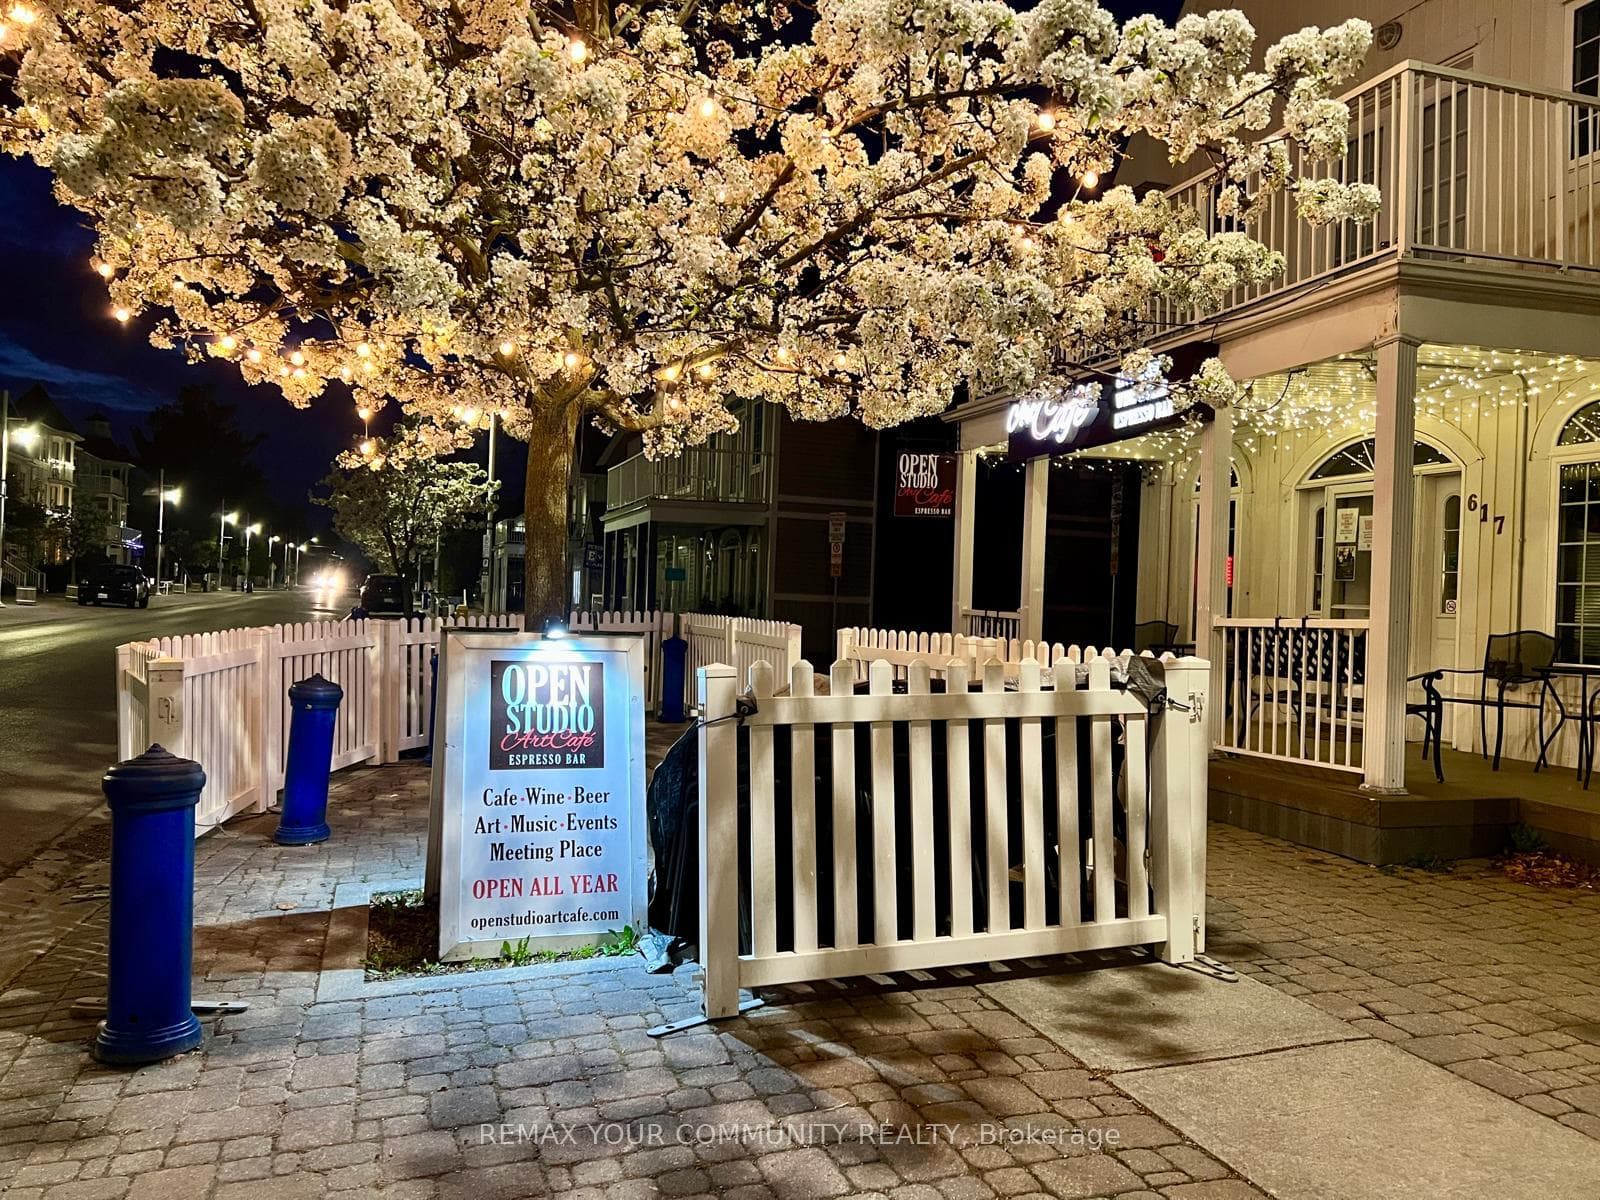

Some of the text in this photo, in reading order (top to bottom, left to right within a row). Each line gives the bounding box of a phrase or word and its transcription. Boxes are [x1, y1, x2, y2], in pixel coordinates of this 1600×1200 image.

[899, 453, 939, 475] OPEN
[900, 473, 938, 489] STUDIO
[914, 507, 940, 515] ESPRESSO
[502, 664, 591, 706] OPEN
[506, 703, 594, 734] STUDIO
[508, 753, 587, 766] ESPRESSO BAR
[483, 786, 611, 806] Cafe Wine Beer
[474, 813, 618, 834] Art Music Events
[490, 839, 603, 862] Meeting Place
[472, 873, 619, 900] OPEN ALL YEAR
[470, 906, 619, 931] openstudioartcafe.com
